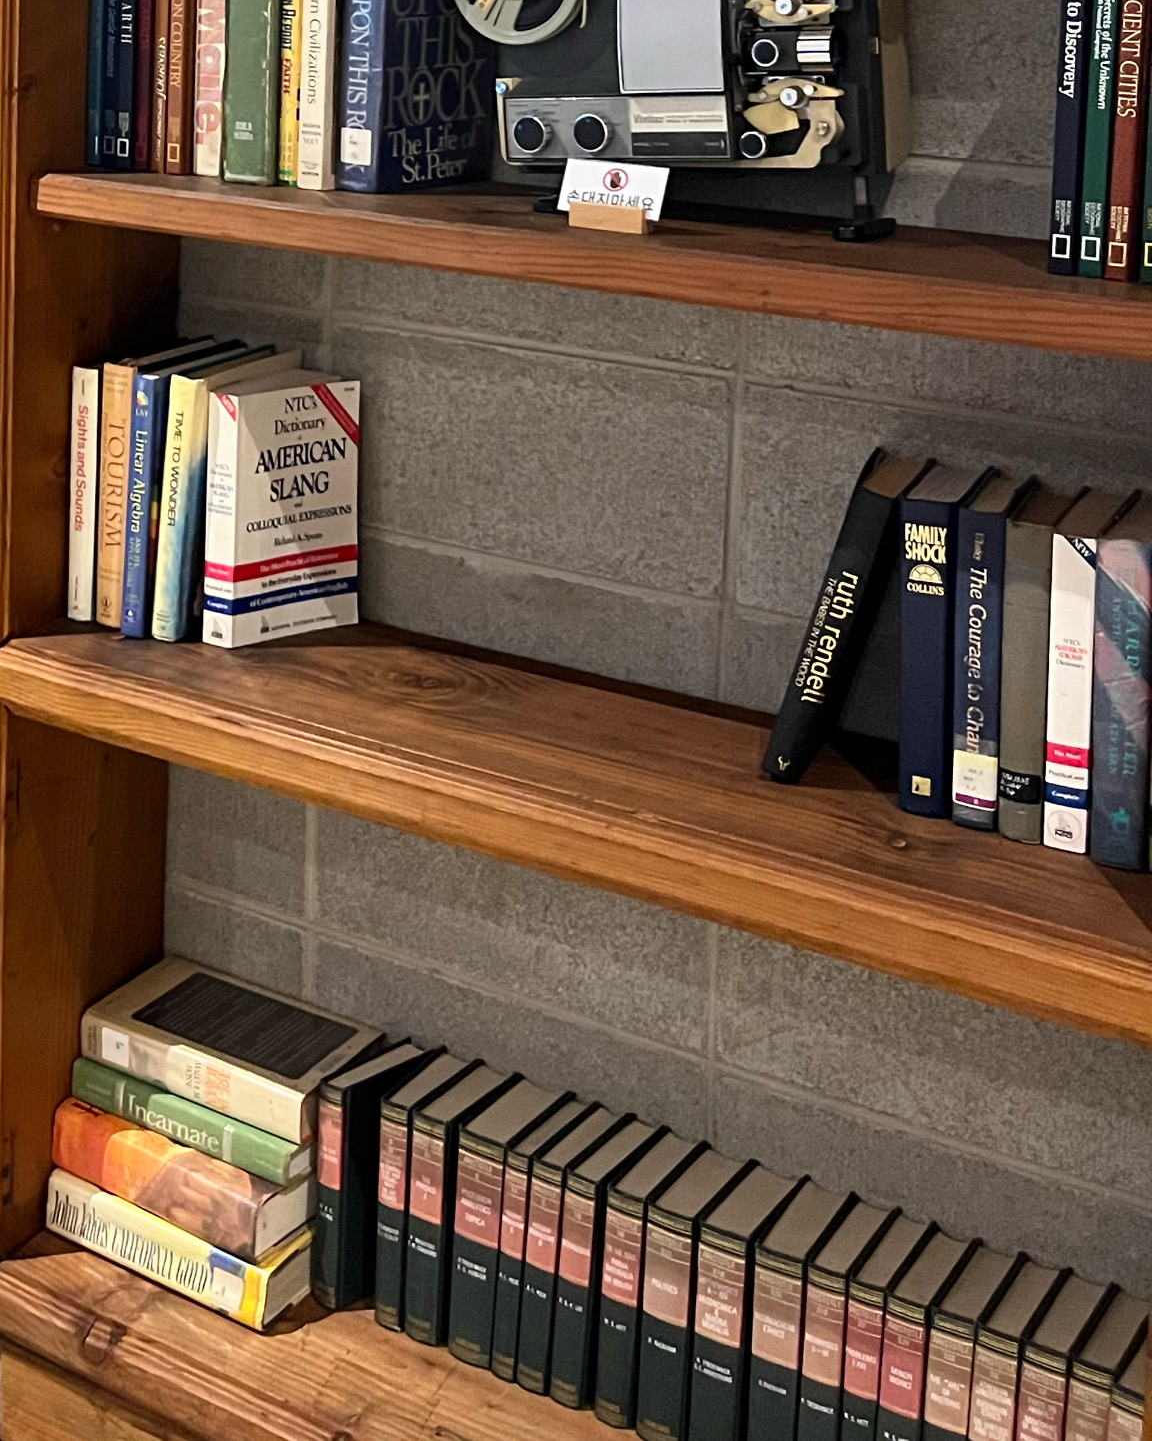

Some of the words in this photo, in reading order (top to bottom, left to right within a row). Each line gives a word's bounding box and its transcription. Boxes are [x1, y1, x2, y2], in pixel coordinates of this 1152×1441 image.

[1067, 1, 1082, 17] to
[398, 16, 476, 70] THIS
[1100, 31, 1112, 42] of
[1100, 43, 1111, 58] the
[156, 36, 167, 98] JOURNEYS
[170, 22, 182, 87] COUNTRY
[308, 19, 322, 104] Civilizations
[1058, 21, 1082, 98] Discovery
[282, 58, 292, 94] FAITH
[348, 51, 369, 104] THIS
[1096, 61, 1110, 109] Unknown
[1117, 59, 1139, 117] CITIES
[384, 59, 487, 131] ROCK
[388, 130, 422, 157] The
[426, 125, 457, 153] Life
[402, 156, 426, 183] St.
[426, 154, 468, 180] Peter
[567, 190, 654, 211] 손대지마세요
[285, 395, 317, 414] NTC's
[76, 405, 89, 449] Sights
[173, 411, 184, 441] TIME
[275, 417, 326, 435] Dictionary
[76, 452, 86, 478] and
[133, 430, 148, 474] Linear
[172, 445, 181, 462] TO
[255, 438, 347, 474] AMERICAN
[104, 418, 126, 548] TOURISM
[167, 466, 179, 526] WONDER
[270, 471, 329, 502] SLANG
[74, 480, 86, 532] Sounds
[130, 479, 145, 533] Algebra
[247, 514, 297, 533] COLLOQUIAL
[299, 504, 352, 523] EXPRESSIONS
[905, 522, 947, 545] FAMILY
[1072, 538, 1091, 557] NEW
[905, 541, 946, 564] SHOCK
[825, 577, 837, 596] THE
[829, 570, 859, 619] ruth
[907, 582, 945, 596] COLLINS
[969, 568, 988, 598] The
[814, 596, 831, 627] BABES
[811, 626, 821, 638] IN
[964, 604, 985, 678] Courage
[801, 624, 841, 704] rendell
[804, 639, 818, 658] THE
[795, 657, 810, 687] WOOD
[128, 1093, 219, 1152] Incarnate
[50, 1189, 79, 1234] John
[79, 1207, 108, 1246] Jakes
[112, 1223, 174, 1282] CALIFORNIA
[176, 1255, 208, 1294] GOLD
[651, 1278, 678, 1295] POLITICS
